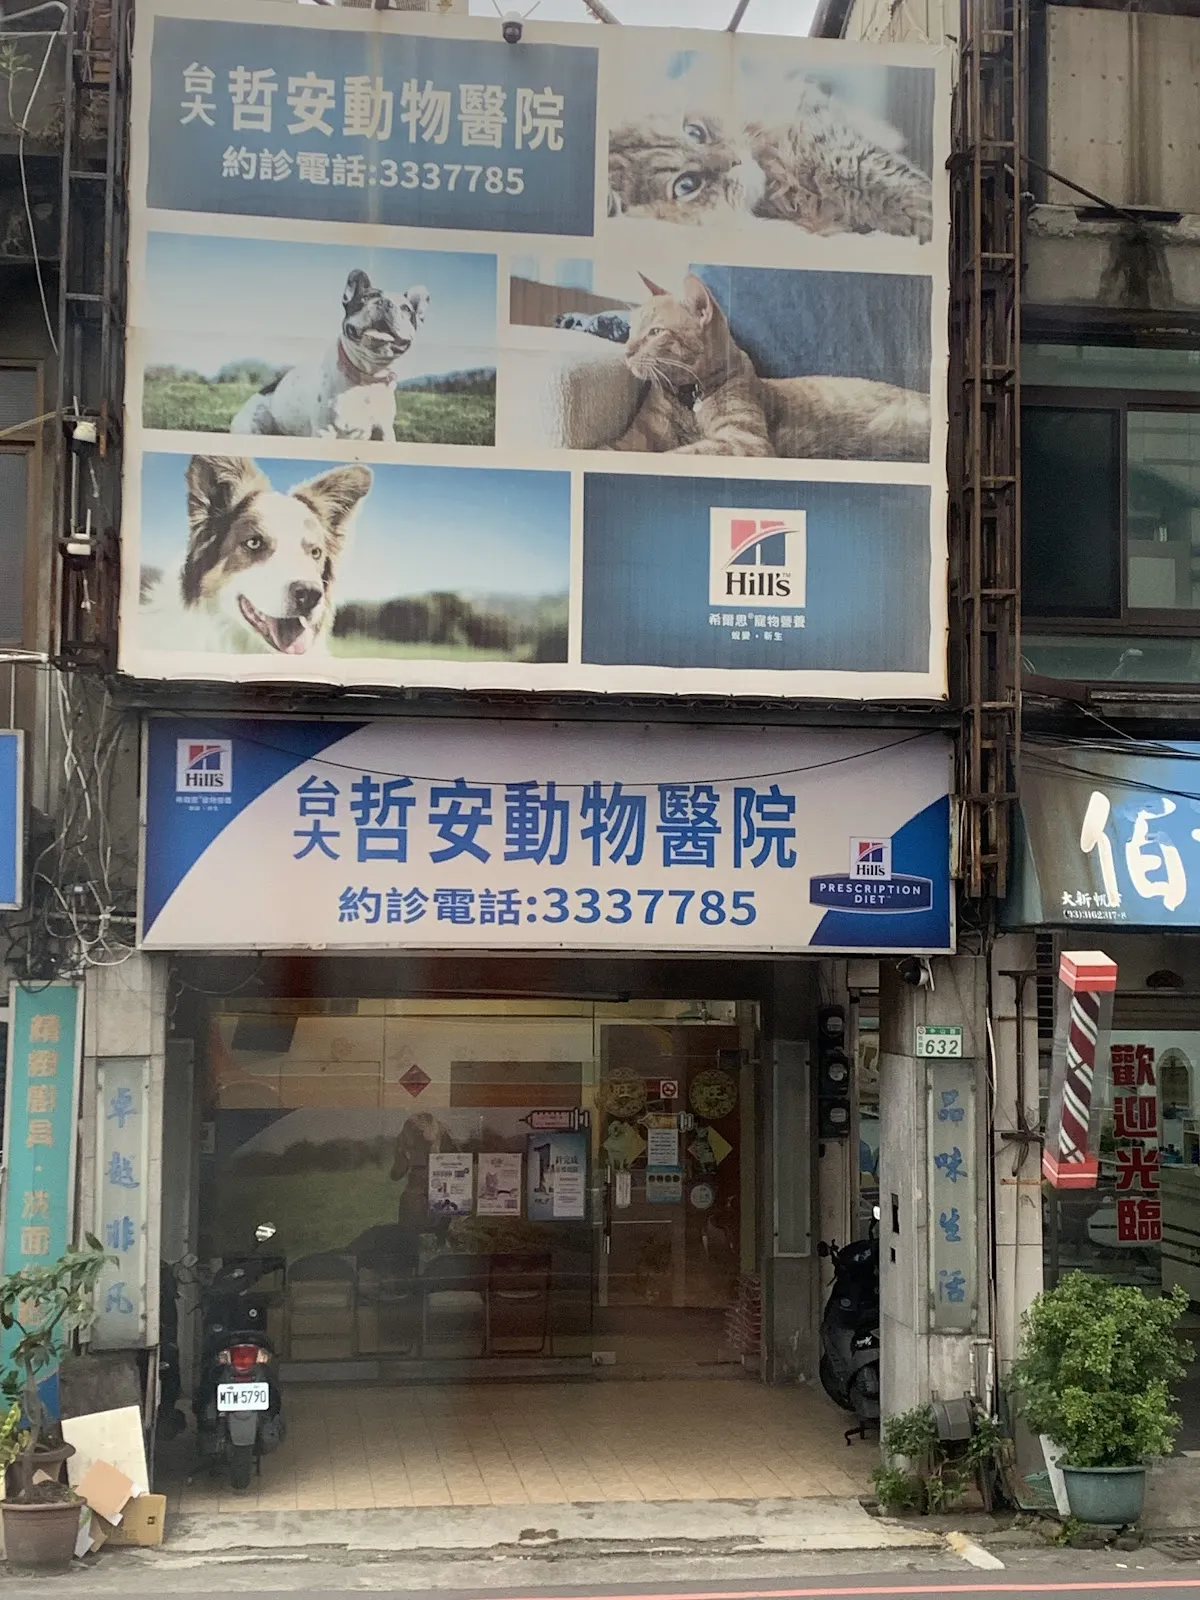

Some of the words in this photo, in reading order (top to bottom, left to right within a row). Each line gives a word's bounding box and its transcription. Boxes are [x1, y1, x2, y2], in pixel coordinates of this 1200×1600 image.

[185, 772, 225, 788] Hill's
[856, 863, 886, 877] Hill's
[820, 882, 921, 895] PRESCRIPTION
[854, 894, 886, 905] DIET
[925, 1039, 959, 1055] 632
[1110, 1044, 1162, 1242] 歡迎光臨
